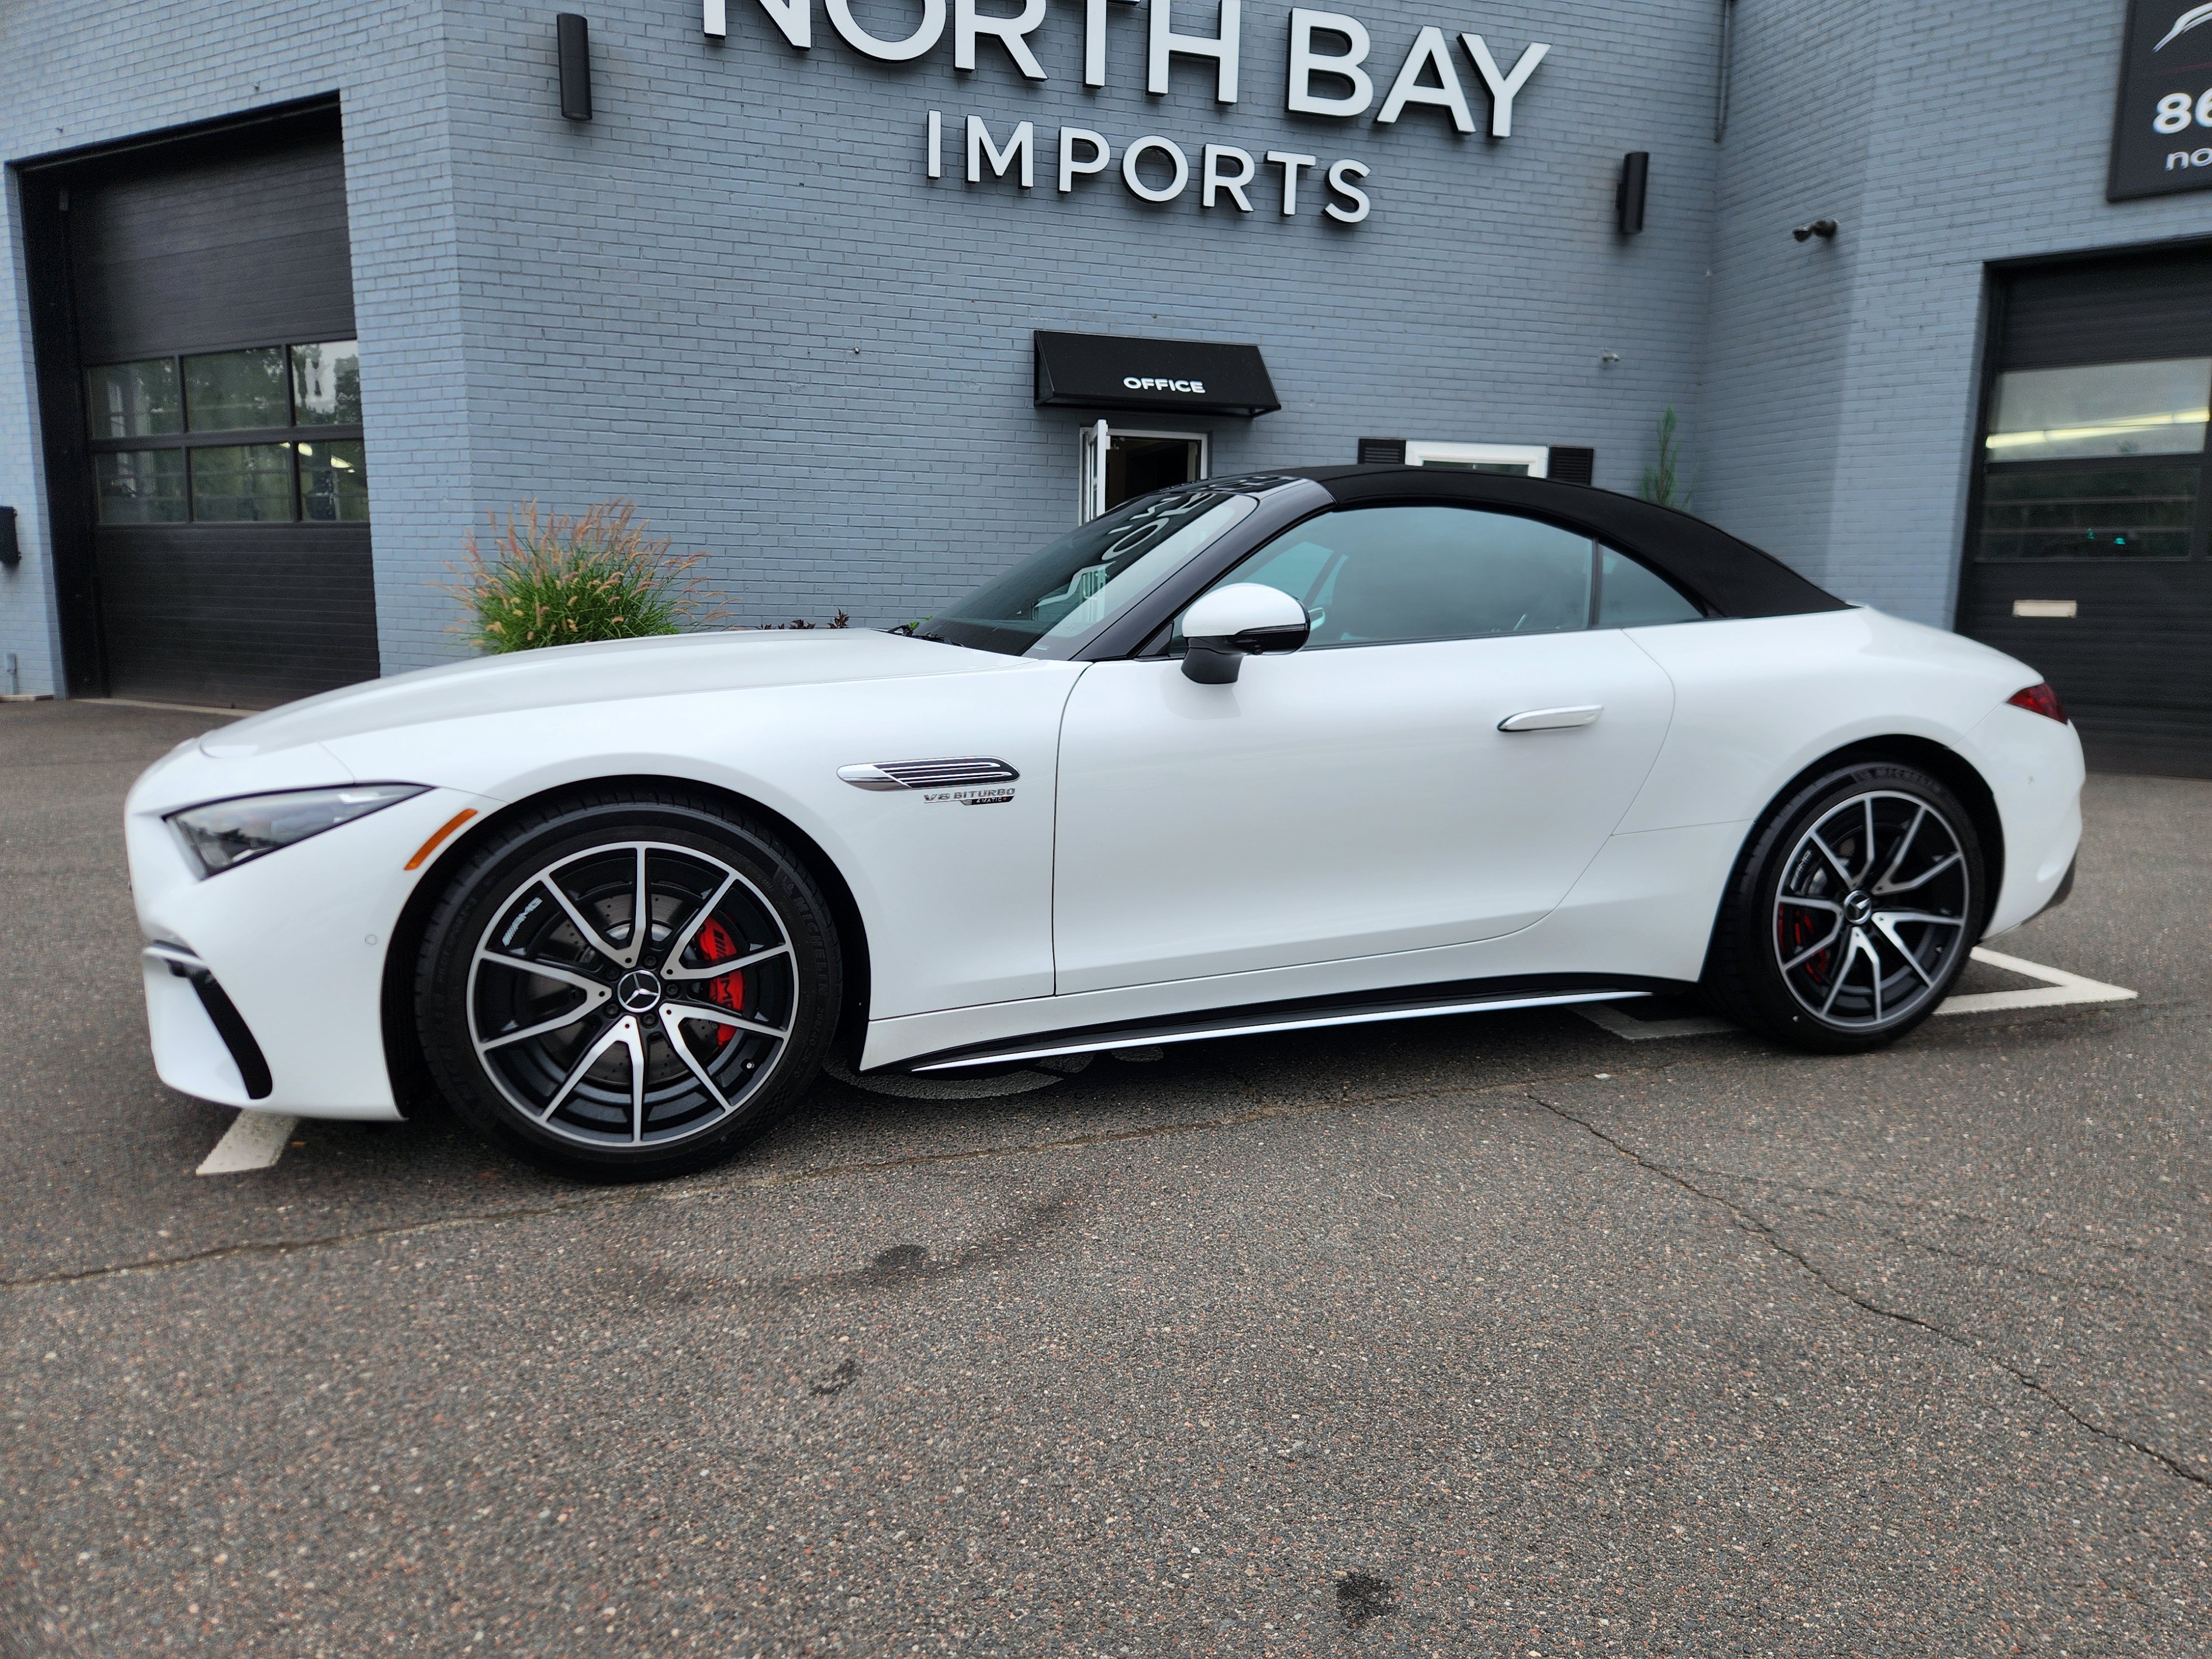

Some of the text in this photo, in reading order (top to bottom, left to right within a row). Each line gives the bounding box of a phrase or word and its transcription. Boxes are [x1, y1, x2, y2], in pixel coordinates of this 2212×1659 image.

[1288, 6, 1552, 139] BAY
[927, 109, 1372, 223] IMPORTS
[1123, 376, 1206, 393] OFFICE
[924, 787, 1016, 801] V8 BITURBO
[792, 896, 828, 997] MICHELIN
